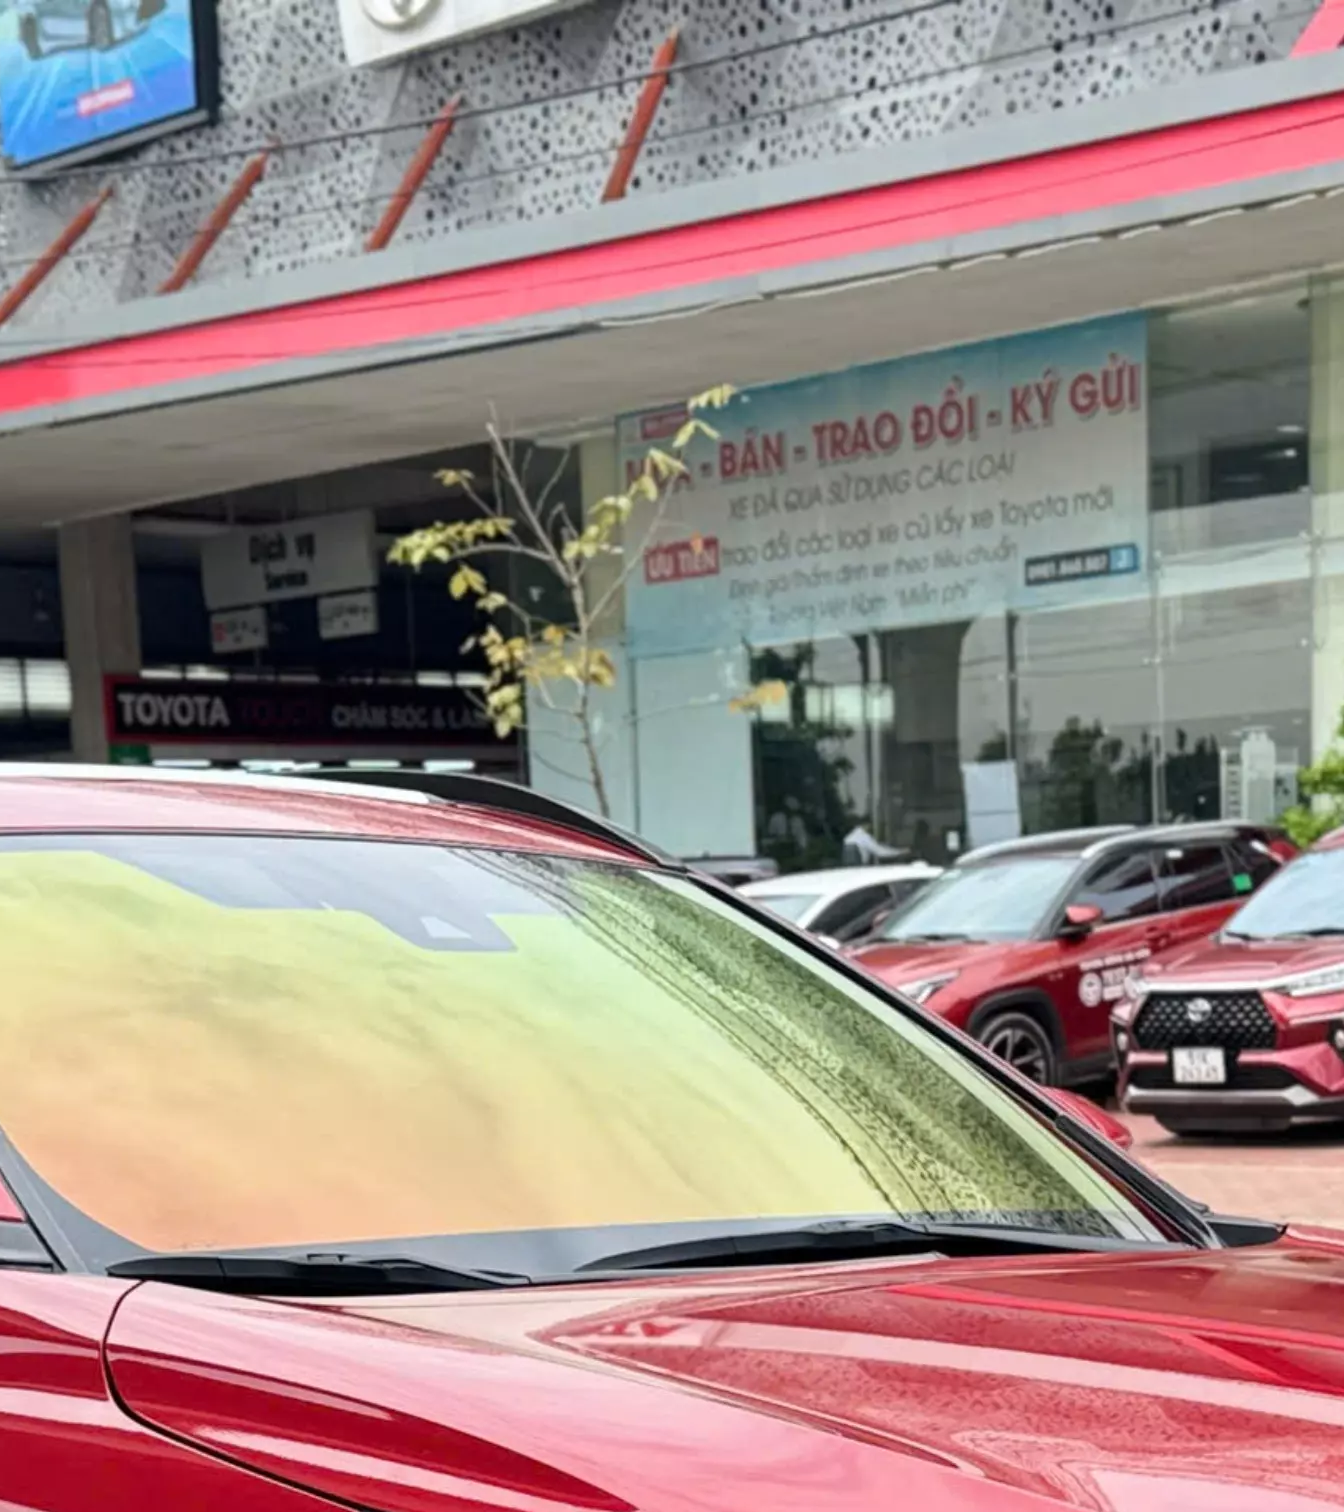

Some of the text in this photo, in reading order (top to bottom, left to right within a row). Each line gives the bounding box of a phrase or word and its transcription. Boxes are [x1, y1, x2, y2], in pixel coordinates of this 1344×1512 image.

[720, 427, 786, 480] BÁN
[812, 412, 901, 464] TRAO
[911, 375, 978, 443] ĐỔI
[1011, 367, 1060, 428] KÝ
[1069, 352, 1141, 415] GỬI
[784, 487, 823, 513] QUA
[854, 469, 911, 502] DỤNG
[916, 458, 964, 491] CÁC
[877, 524, 899, 544] xe
[971, 509, 994, 530] xe
[999, 495, 1068, 528] Toyota
[1073, 484, 1114, 514] mới
[118, 692, 230, 727] TOYOTA
